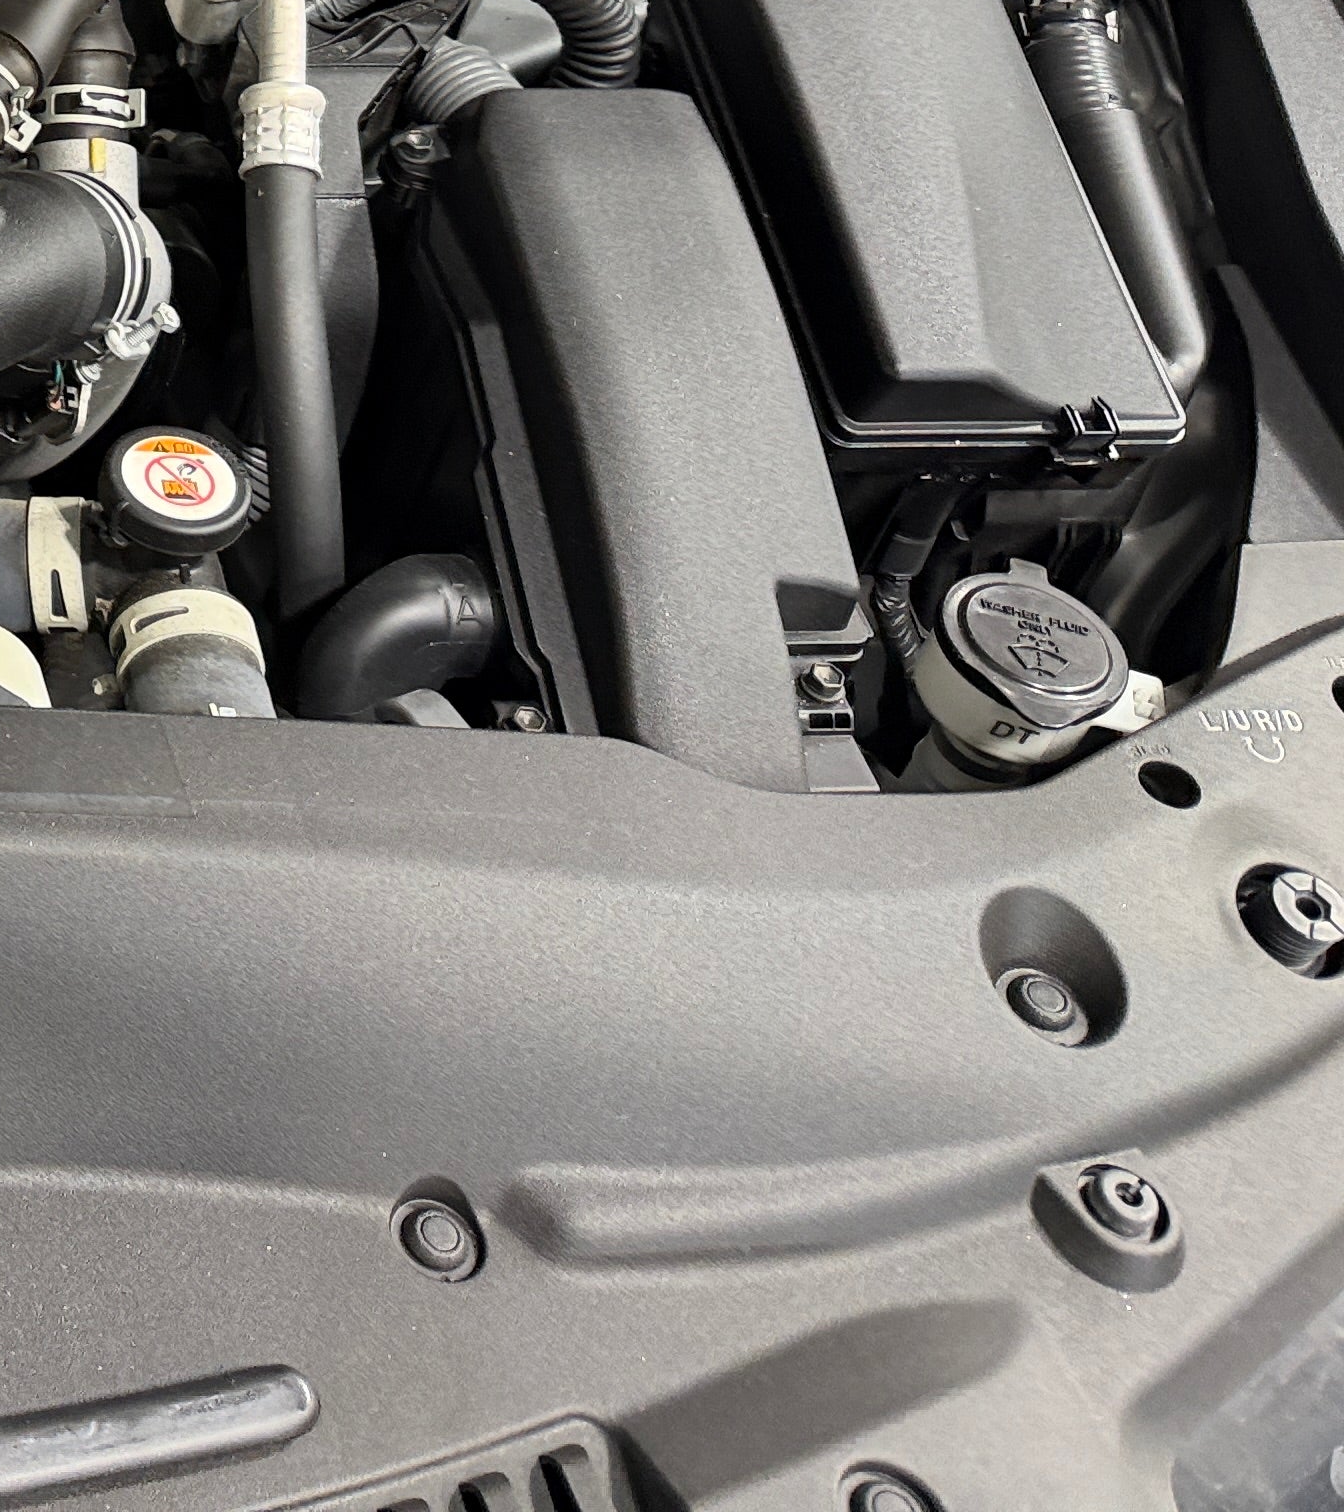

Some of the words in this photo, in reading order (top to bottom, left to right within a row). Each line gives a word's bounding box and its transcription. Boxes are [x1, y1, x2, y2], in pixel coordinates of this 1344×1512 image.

[455, 594, 480, 625] A
[1047, 616, 1091, 637] FLUID
[1198, 708, 1251, 732] L/U
[1252, 708, 1304, 733] R/D
